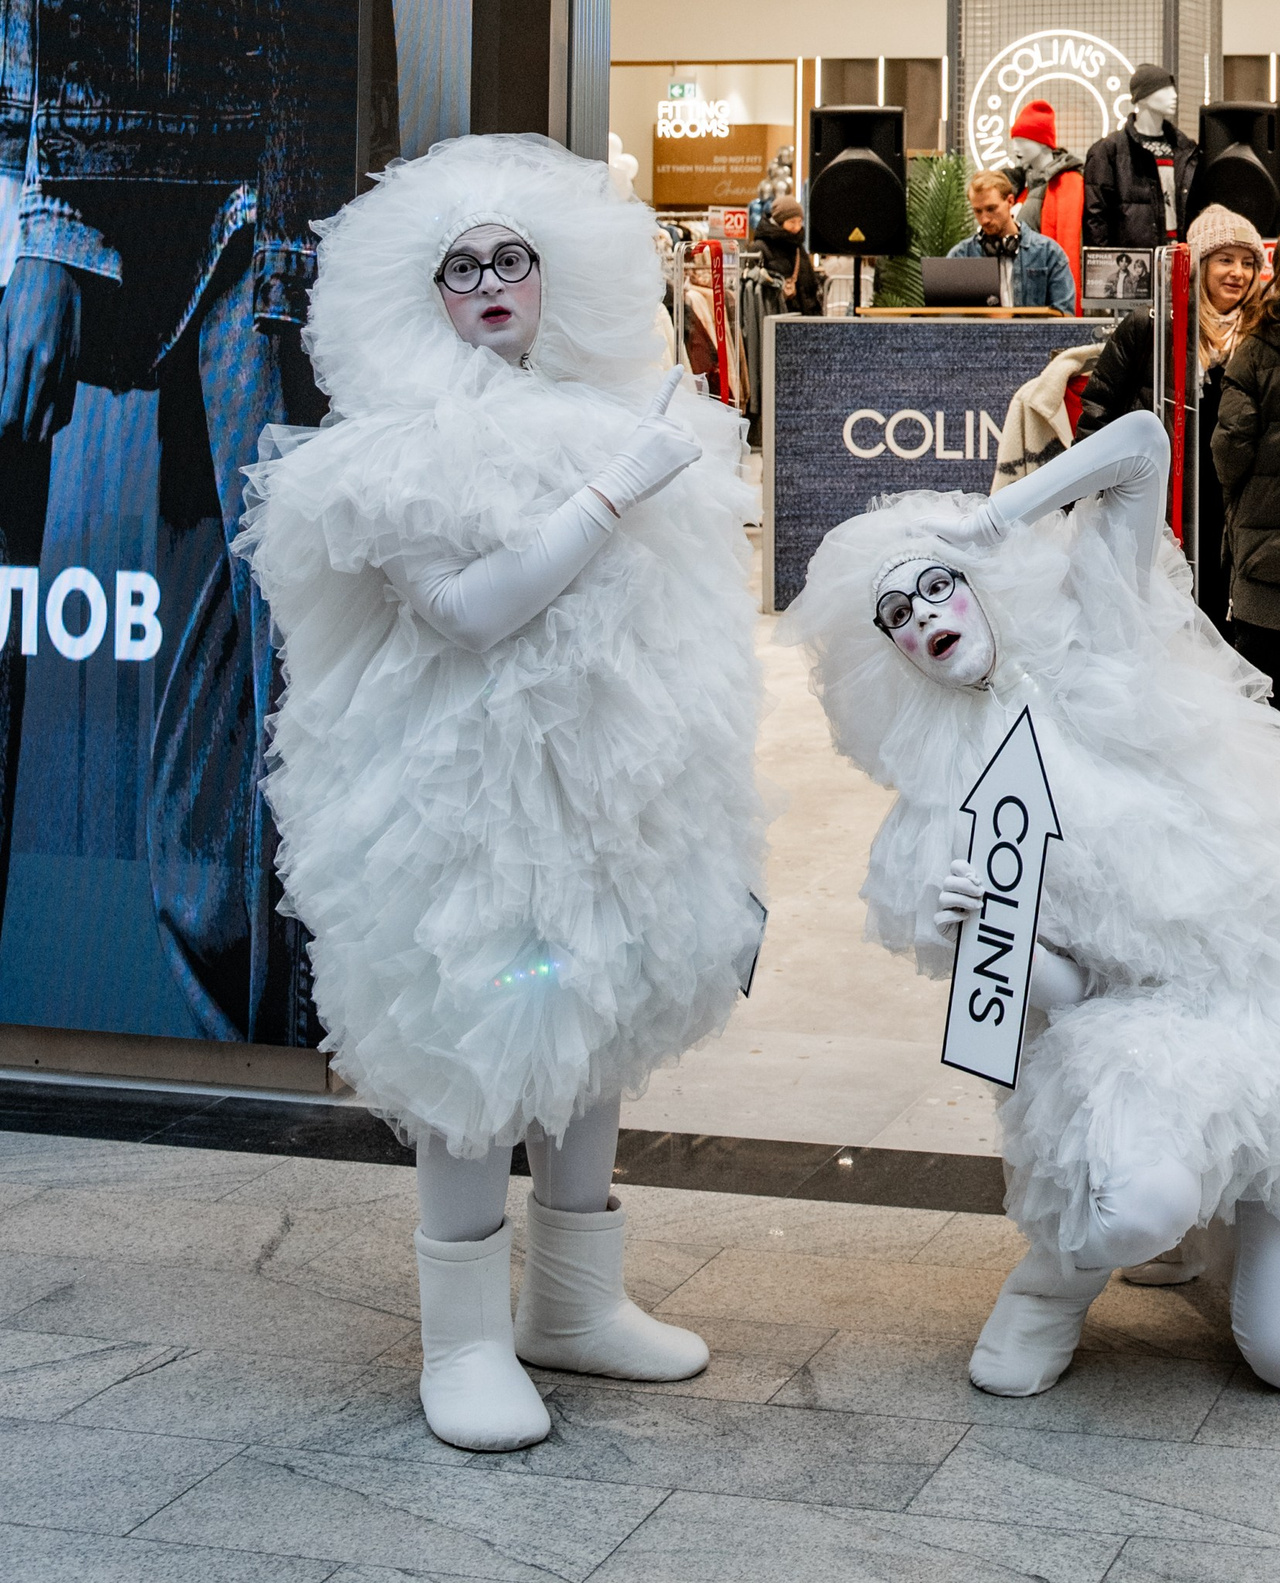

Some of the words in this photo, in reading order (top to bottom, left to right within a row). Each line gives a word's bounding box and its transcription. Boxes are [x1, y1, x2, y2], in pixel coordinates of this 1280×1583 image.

[998, 39, 1106, 92] COLIN'S
[657, 100, 731, 119] FITTING
[657, 119, 730, 138] ROOMS
[976, 114, 1015, 170] IN'S
[657, 165, 671, 173] LET
[672, 165, 694, 173] THEM
[695, 165, 705, 173] TO
[706, 165, 727, 173] HAVE
[729, 165, 762, 173] SECOND
[726, 213, 744, 229] 20
[713, 256, 724, 342] COLIN'S
[843, 409, 1003, 459] COLIN
[0, 566, 163, 661] ЛОВ
[969, 795, 1029, 1027] COLIN'S
